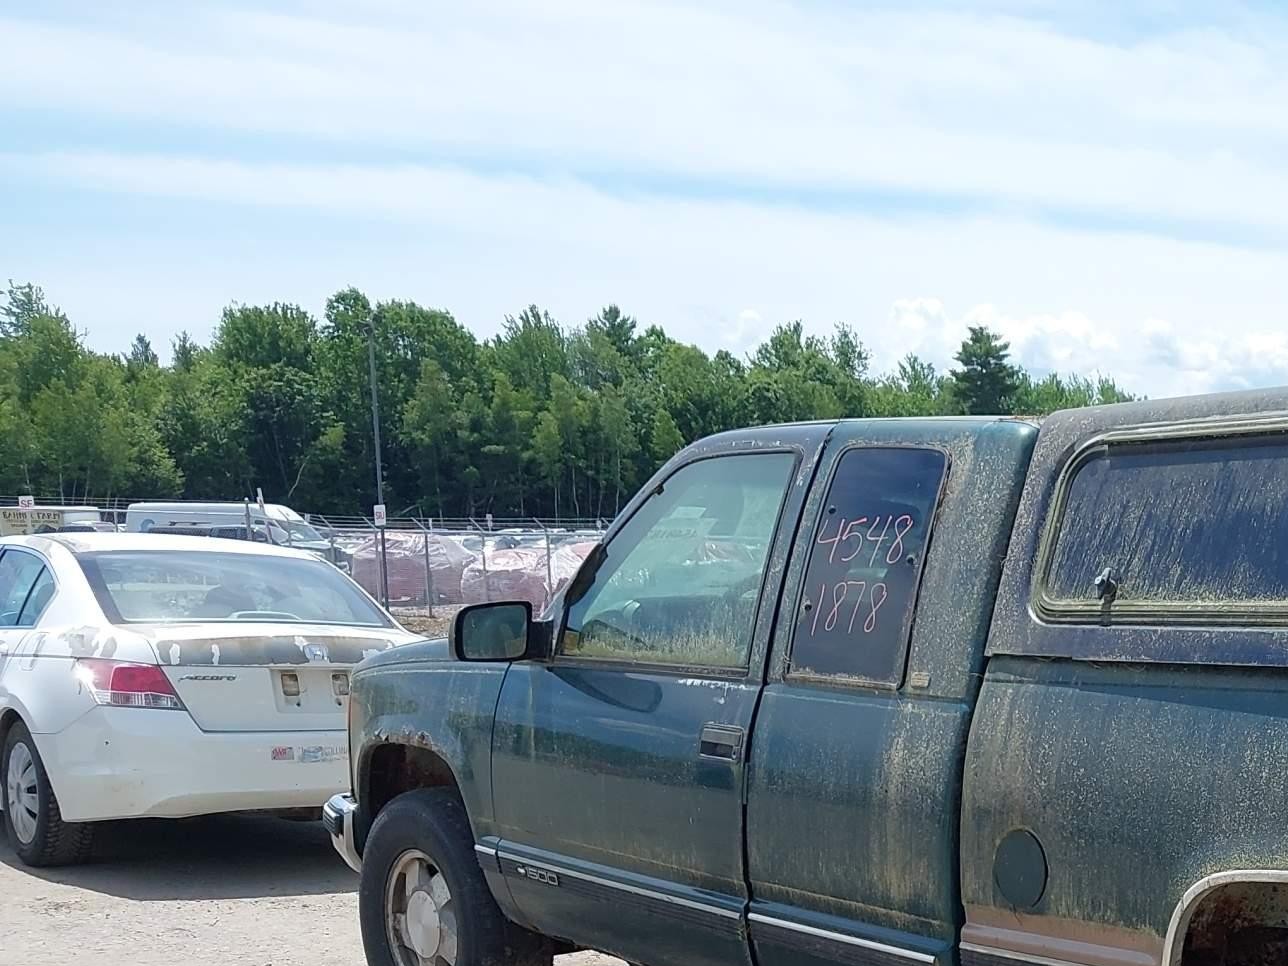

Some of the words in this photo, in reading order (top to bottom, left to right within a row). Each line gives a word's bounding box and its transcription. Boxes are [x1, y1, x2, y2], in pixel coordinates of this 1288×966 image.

[817, 515, 913, 568] 4548
[811, 580, 887, 636] 1878
[525, 866, 559, 886] 1500
